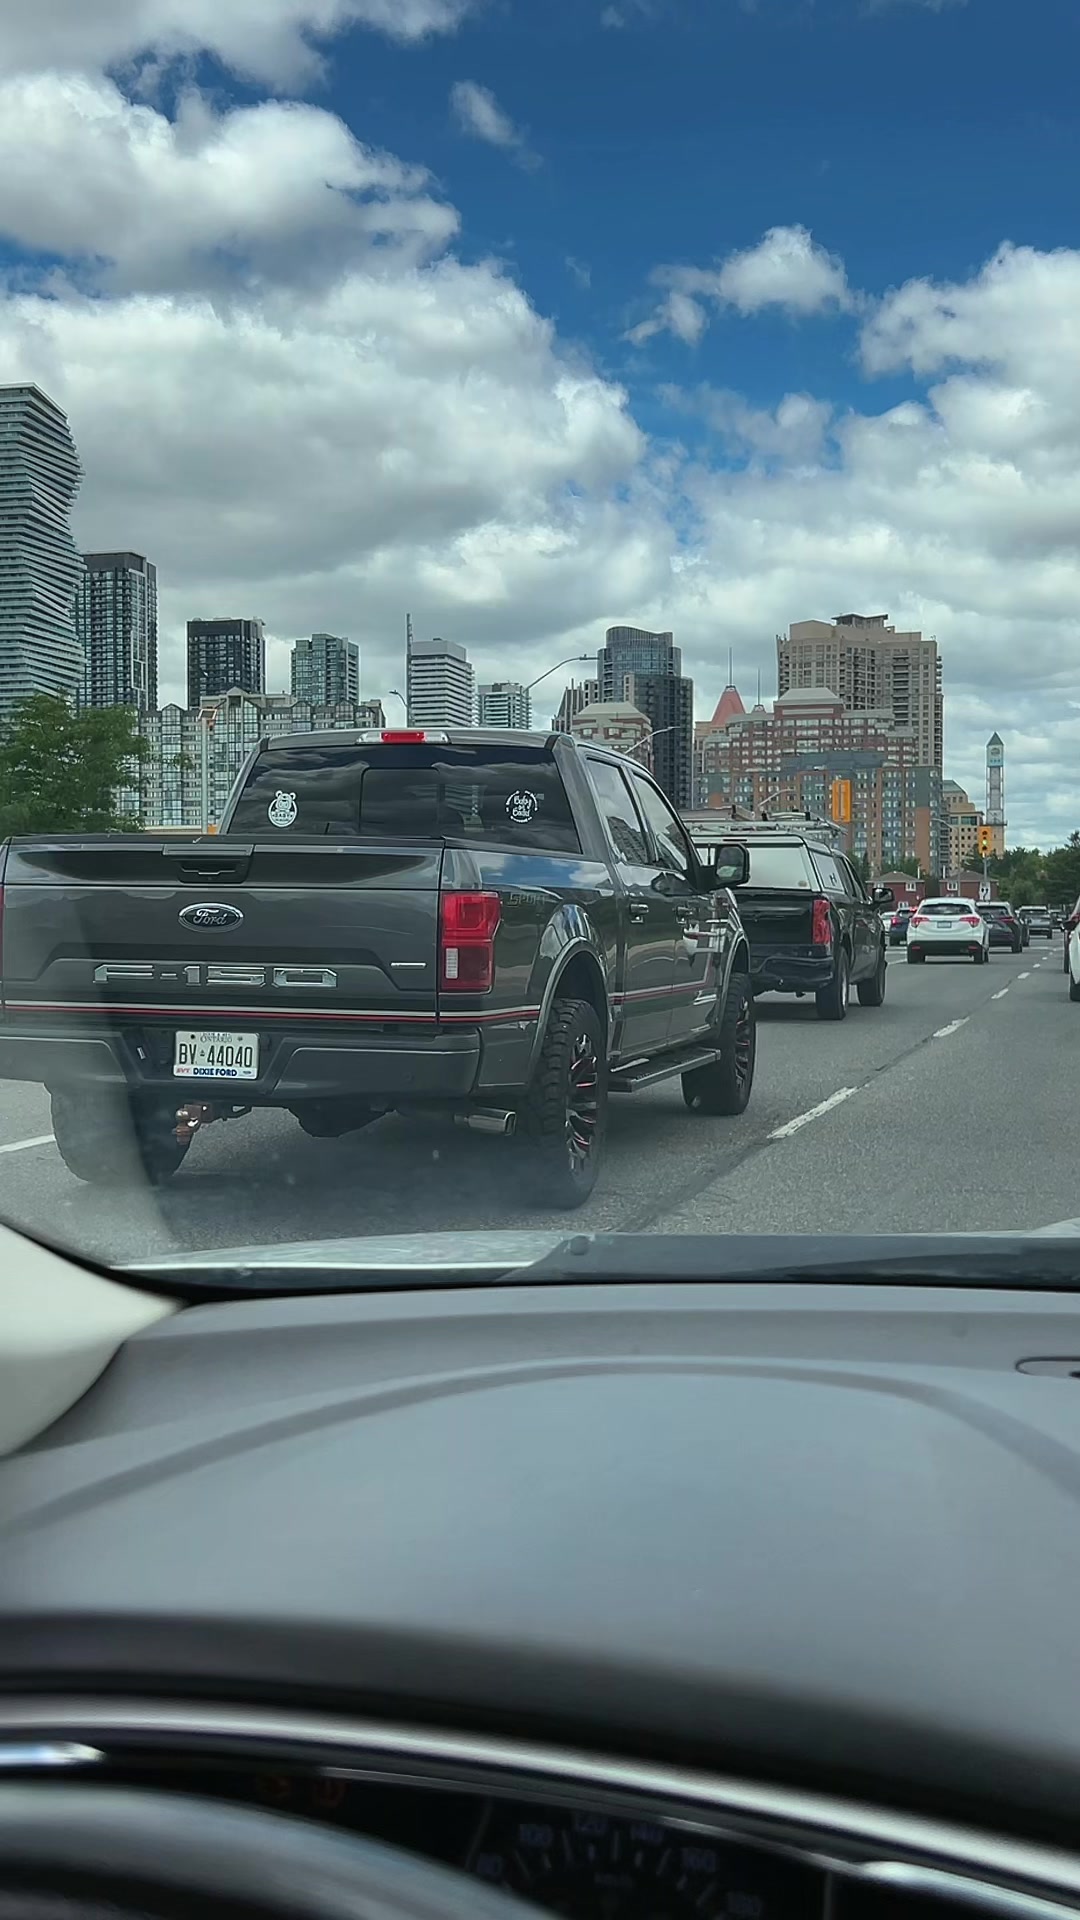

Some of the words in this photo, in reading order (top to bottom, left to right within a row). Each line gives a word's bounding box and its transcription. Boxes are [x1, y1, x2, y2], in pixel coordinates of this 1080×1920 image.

[193, 908, 228, 925] Ford
[93, 964, 338, 988] F-150
[179, 1043, 197, 1065] BV
[207, 1045, 253, 1067] 44040
[193, 1067, 214, 1075] DIXIE
[215, 1068, 238, 1077] FORD
